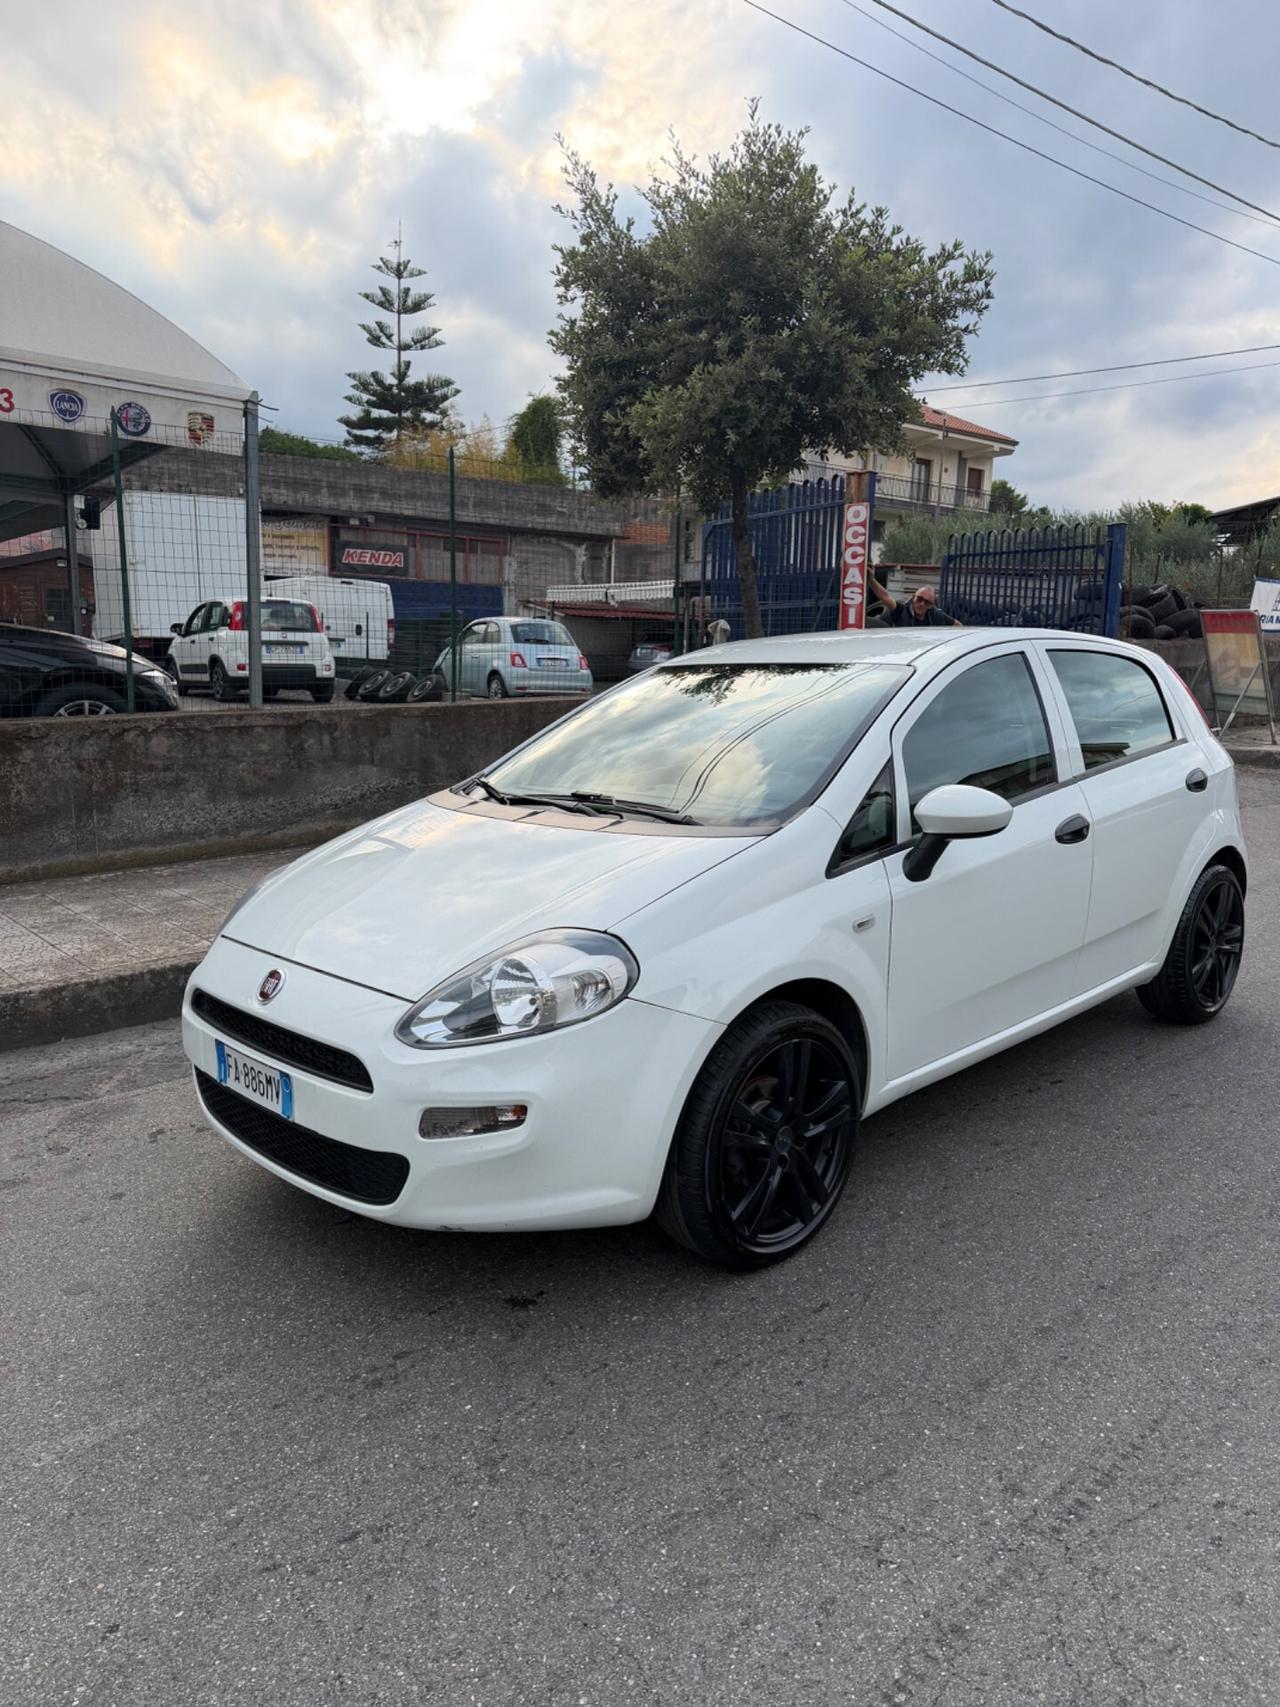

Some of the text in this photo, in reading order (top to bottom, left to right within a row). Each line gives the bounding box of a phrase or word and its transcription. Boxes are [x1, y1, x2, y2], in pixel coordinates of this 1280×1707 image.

[56, 400, 79, 412] LANCIA
[342, 548, 404, 567] KENDA
[843, 504, 868, 630] OCCASI
